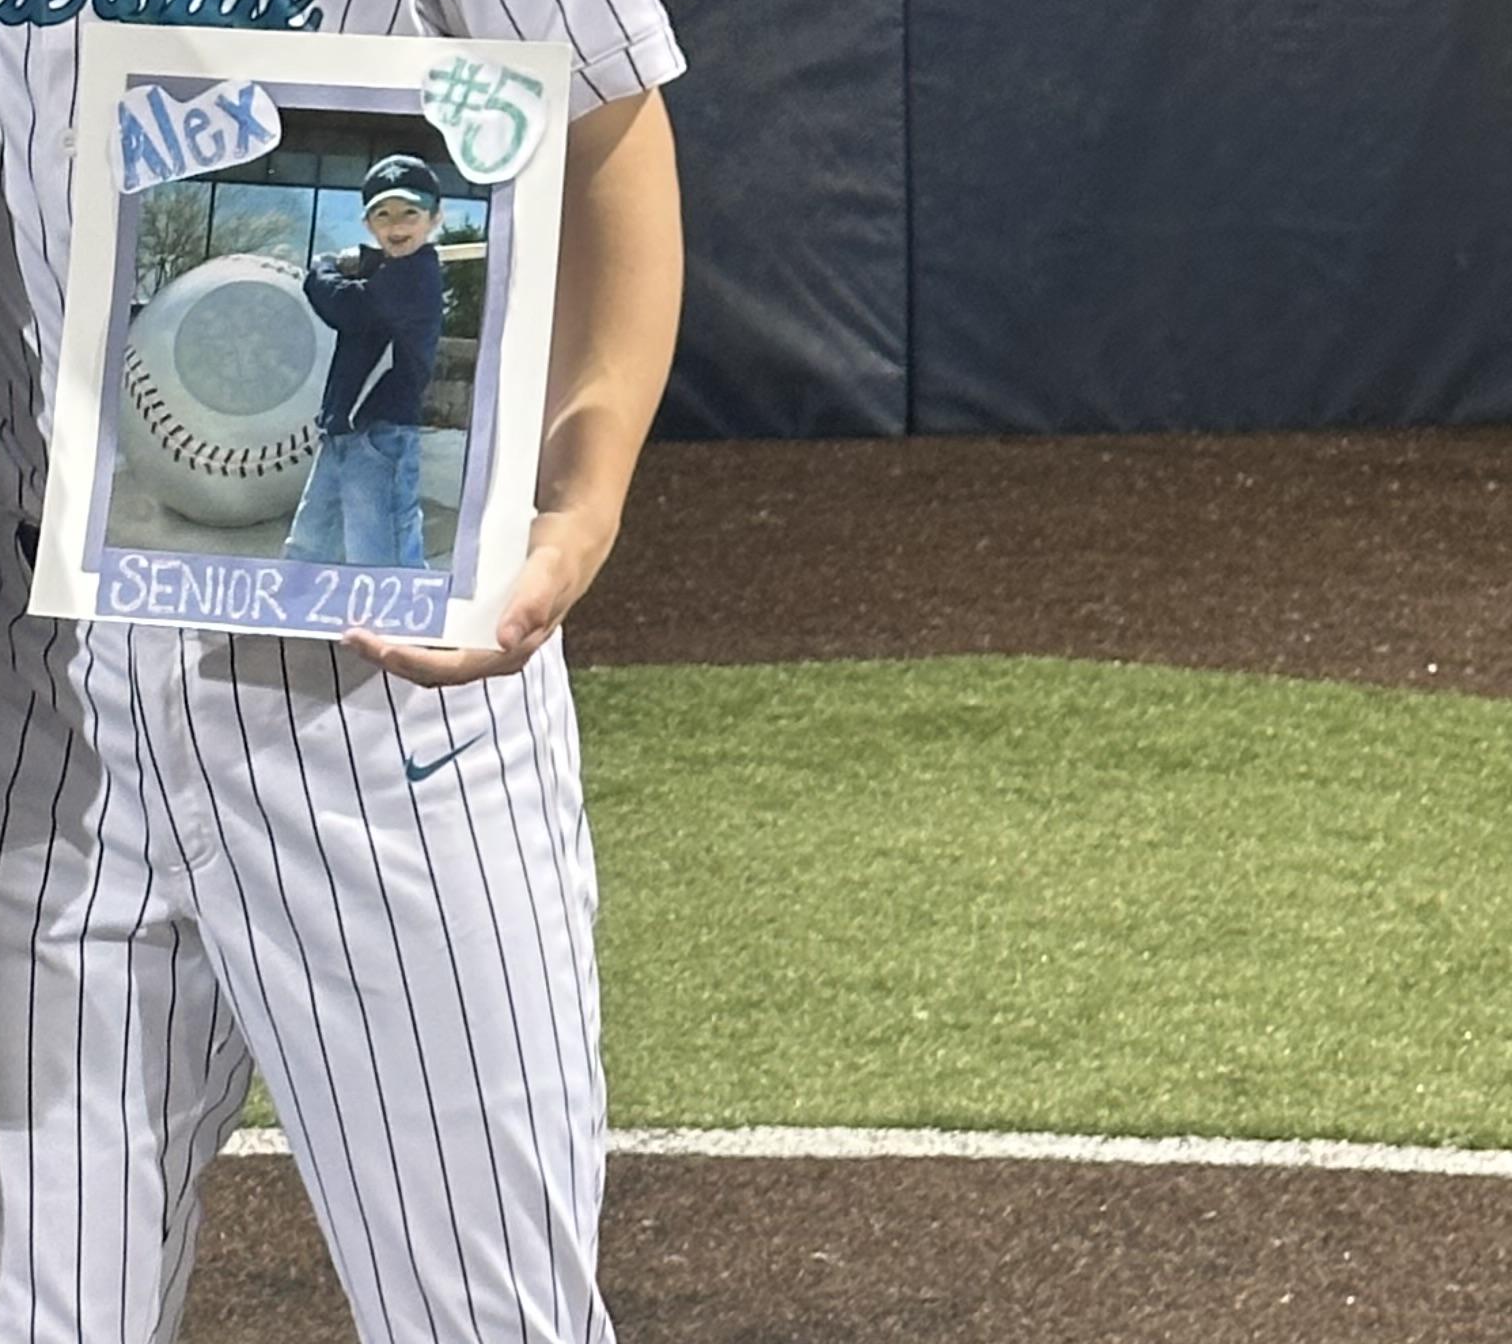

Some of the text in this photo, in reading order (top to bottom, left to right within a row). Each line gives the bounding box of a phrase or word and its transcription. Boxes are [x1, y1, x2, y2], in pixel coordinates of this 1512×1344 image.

[118, 80, 276, 191] Alex
[424, 56, 543, 174] #5
[110, 553, 444, 632] SENIOR 2025
